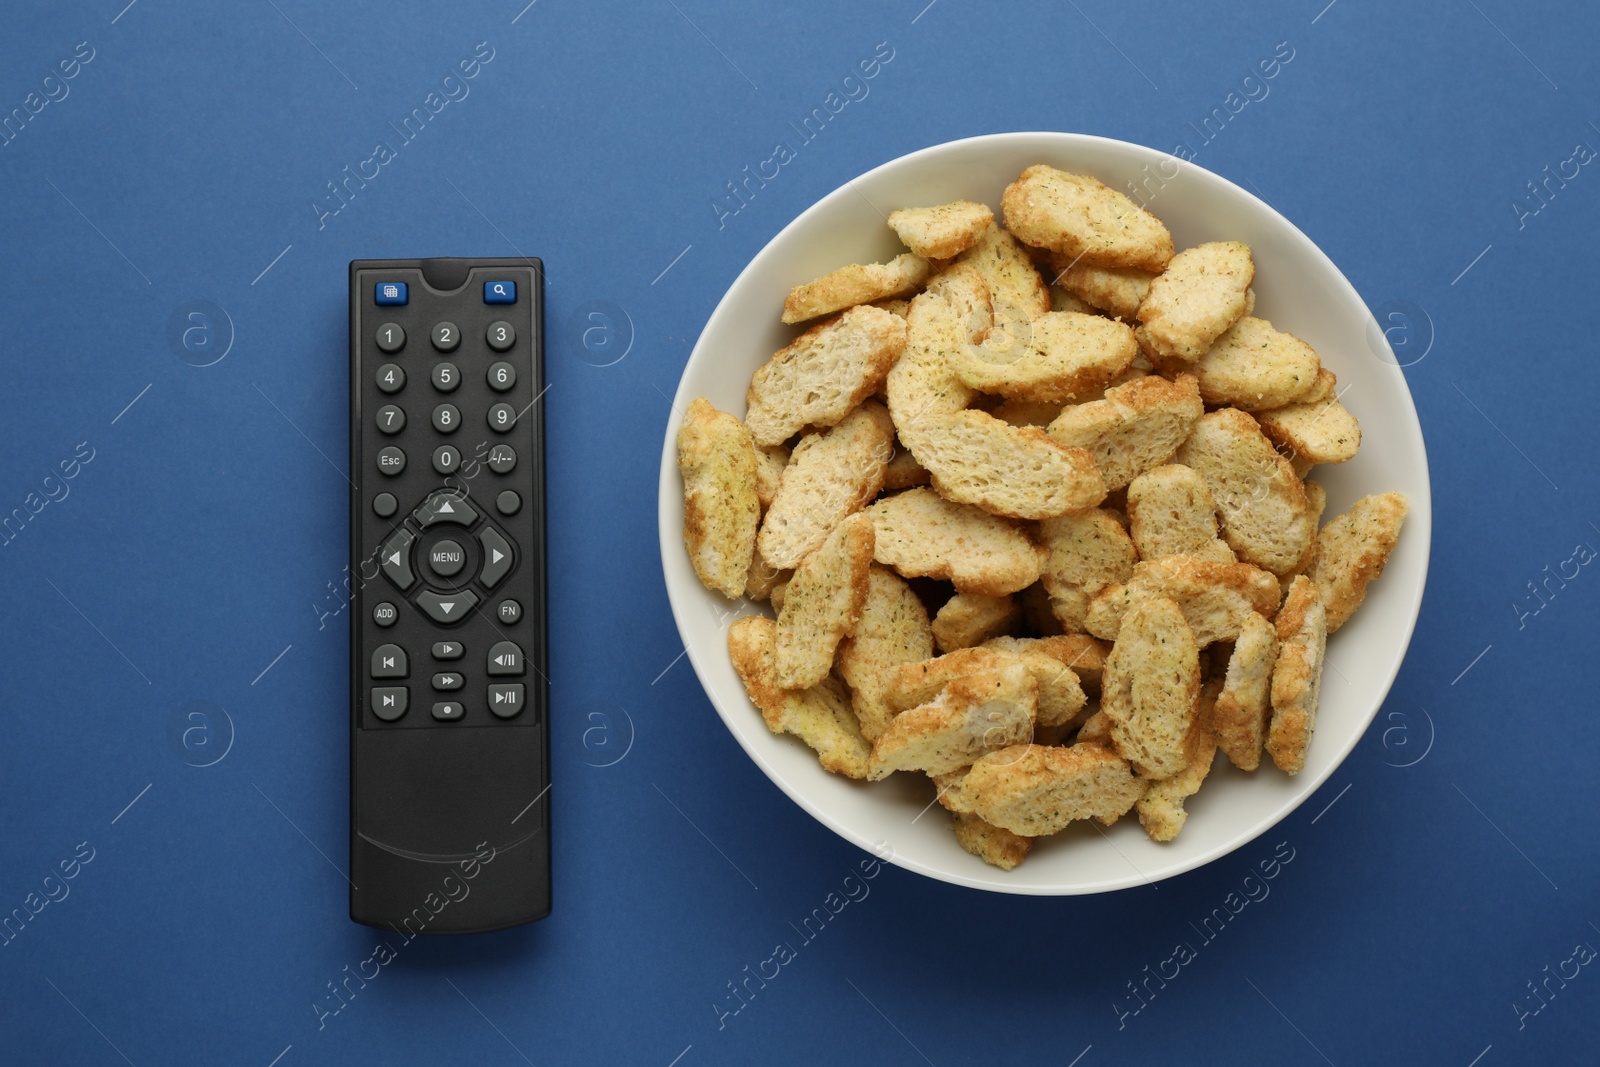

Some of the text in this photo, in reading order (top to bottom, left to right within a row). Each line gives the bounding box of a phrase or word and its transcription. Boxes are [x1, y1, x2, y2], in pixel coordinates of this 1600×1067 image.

[440, 329, 451, 342] 2
[496, 328, 507, 341] 3
[384, 370, 395, 384] 4
[441, 369, 451, 383] 5
[497, 369, 507, 382] 6
[385, 412, 395, 426] 7
[441, 411, 451, 424] 8
[497, 410, 507, 423] 9
[381, 455, 400, 466] Esc
[441, 451, 451, 465] 0
[433, 552, 460, 562] MENU
[376, 608, 393, 618] ADD
[502, 606, 516, 616] FN
